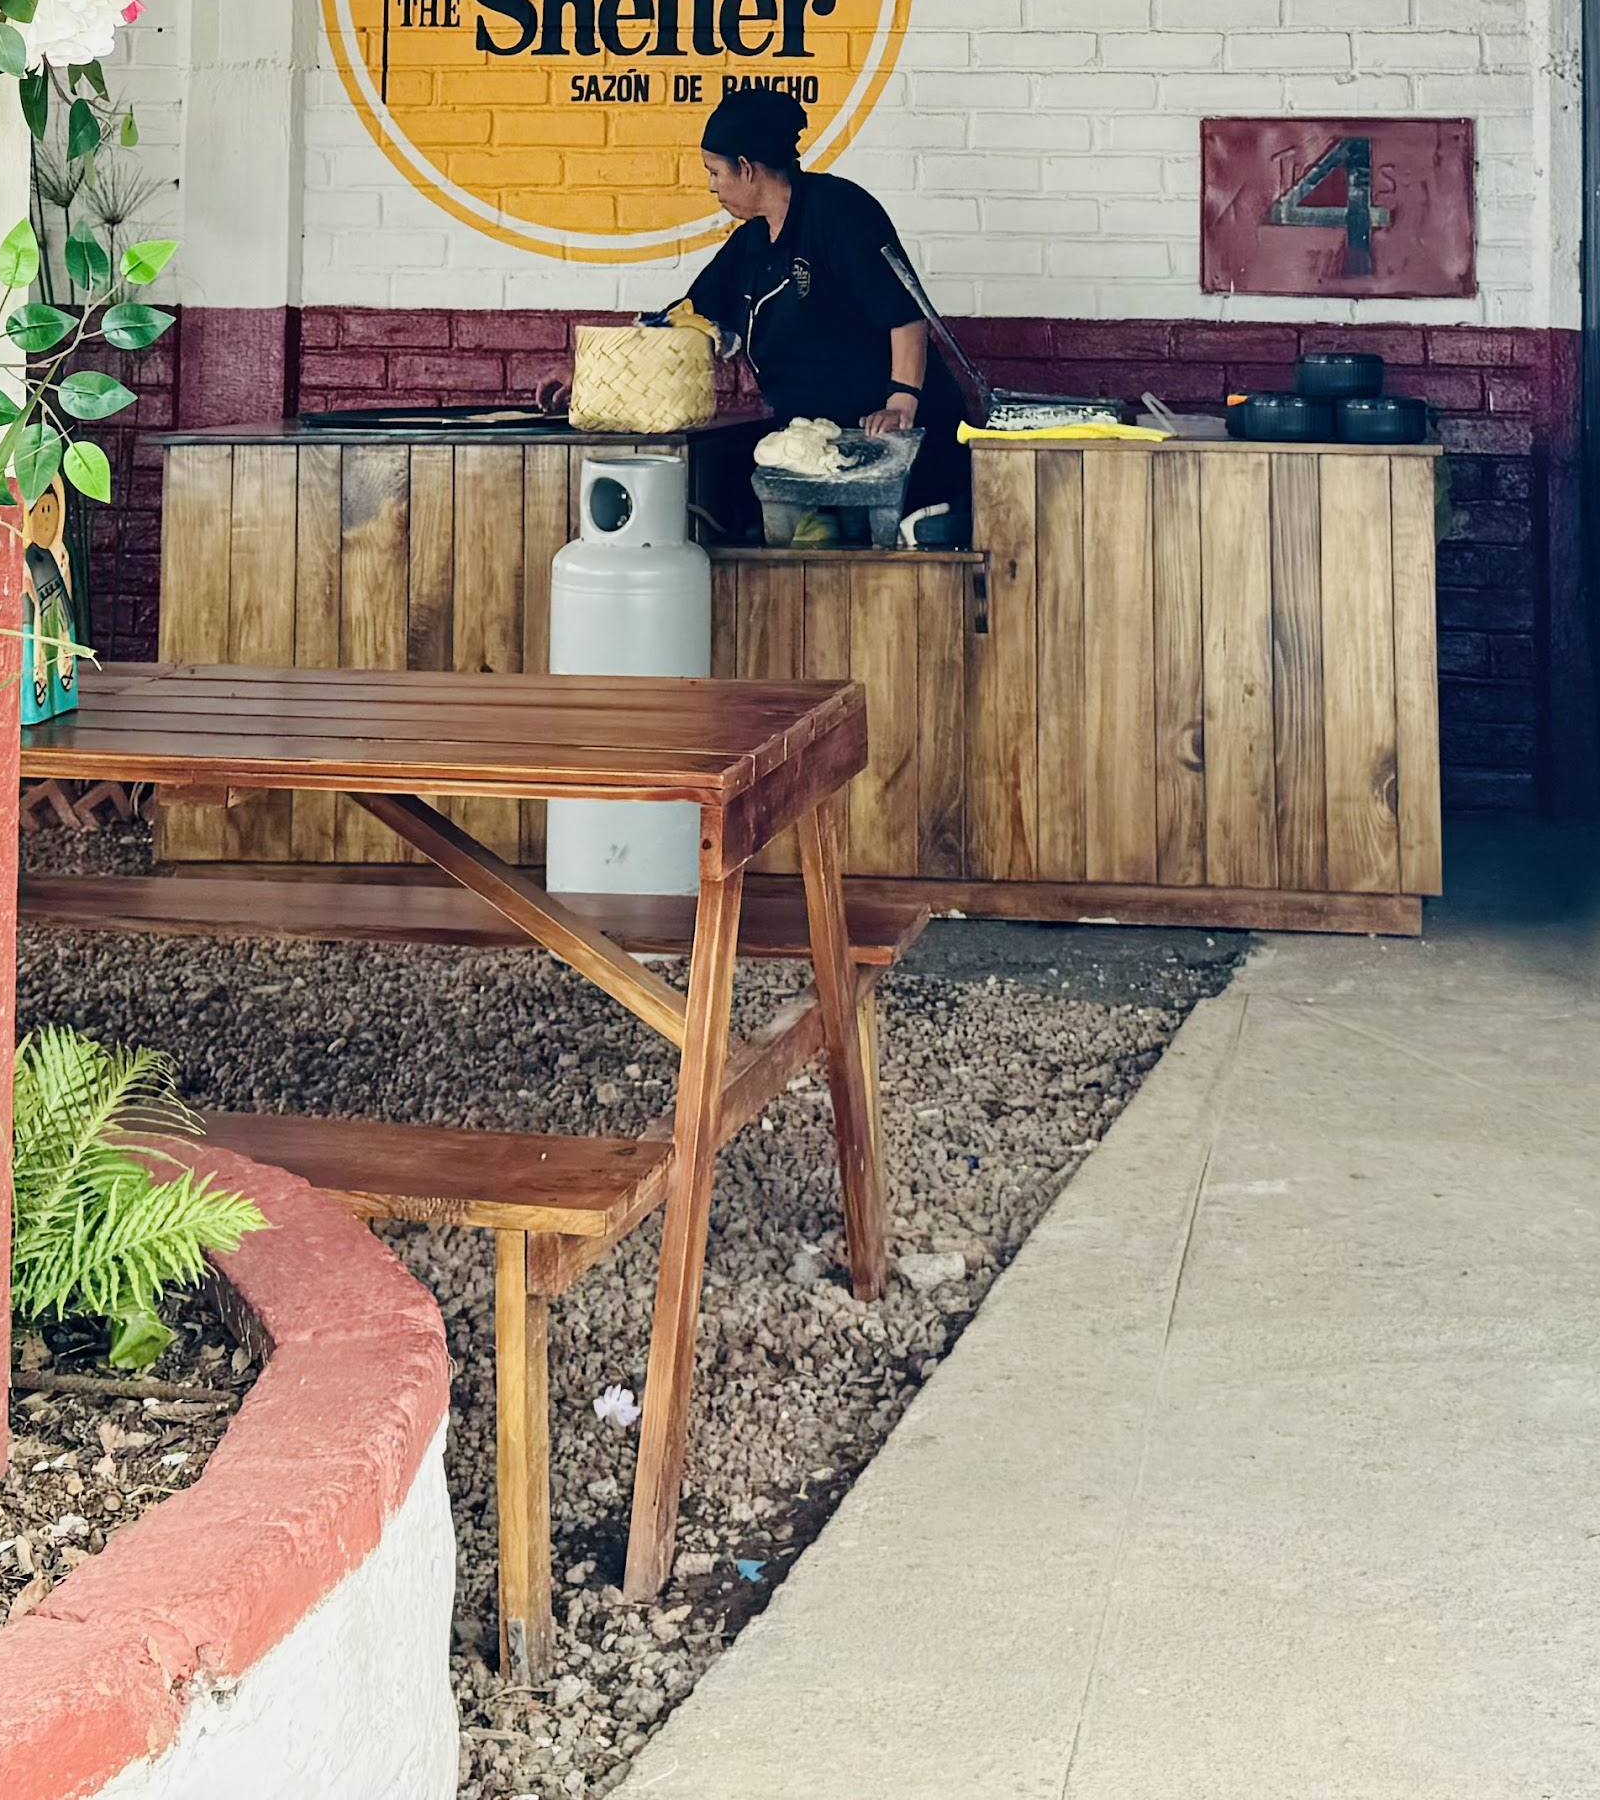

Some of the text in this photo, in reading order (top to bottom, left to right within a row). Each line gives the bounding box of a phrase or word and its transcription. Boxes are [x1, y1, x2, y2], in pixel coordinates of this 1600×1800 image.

[571, 68, 650, 103] SAZÓN
[673, 75, 703, 102] DE
[1268, 136, 1391, 276] 4
